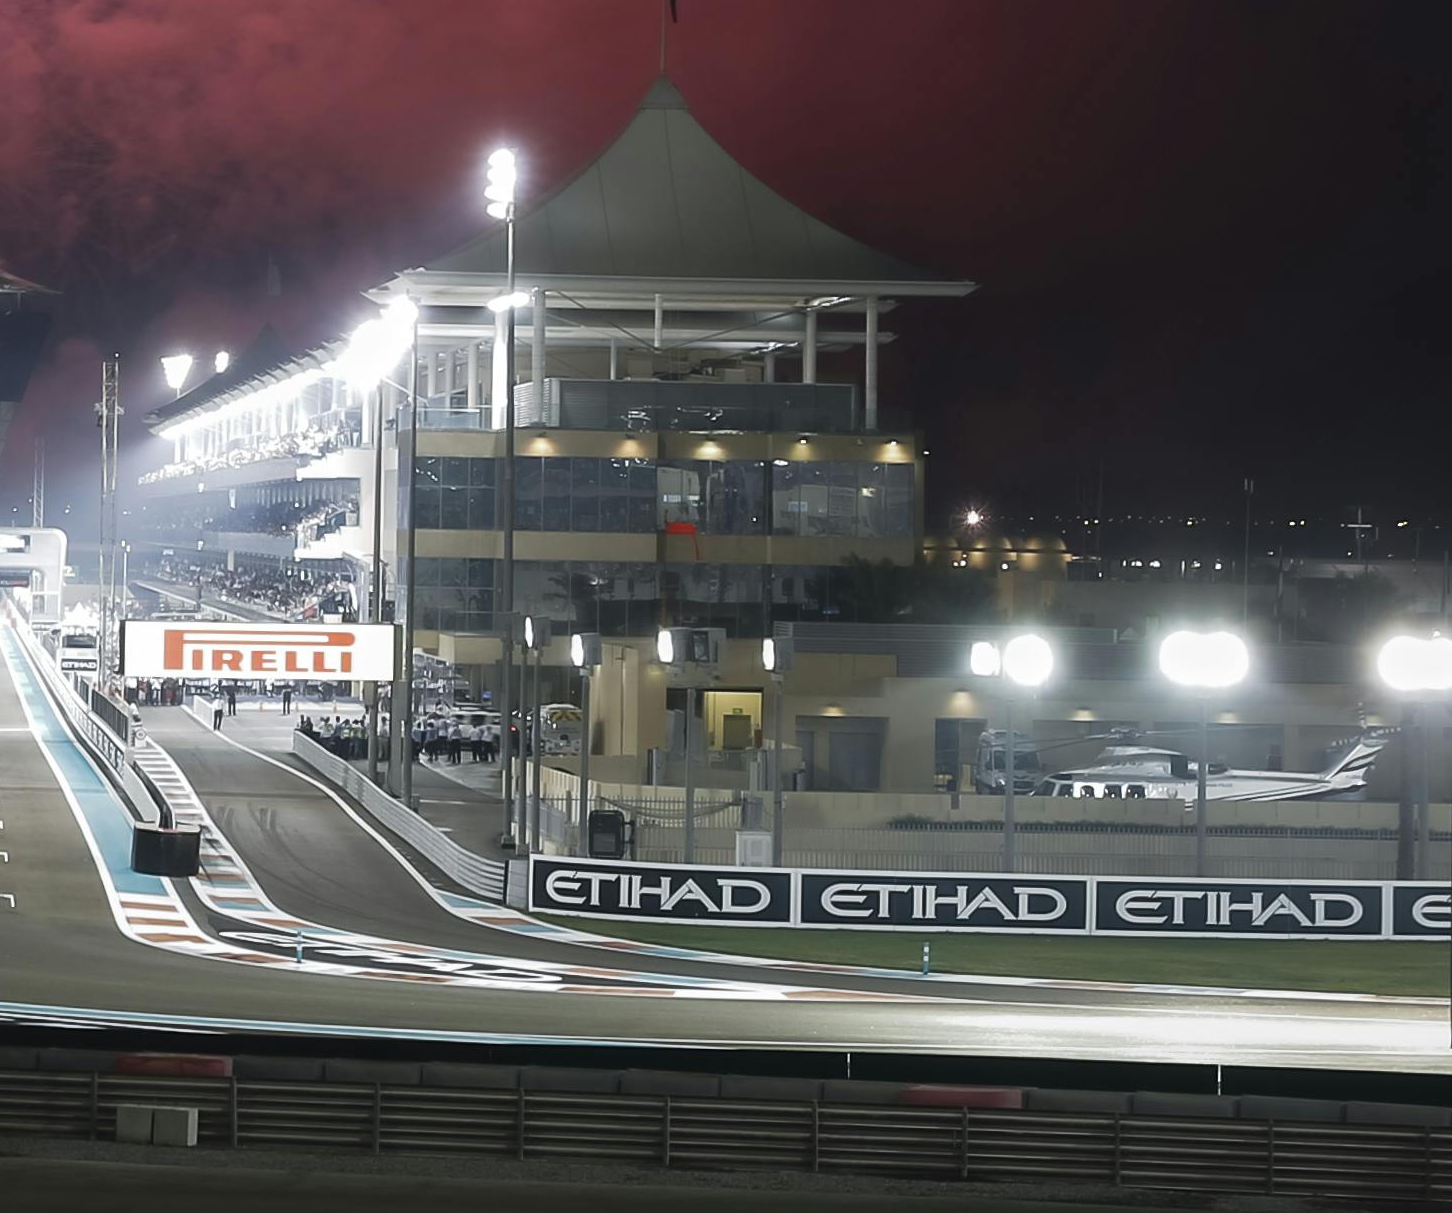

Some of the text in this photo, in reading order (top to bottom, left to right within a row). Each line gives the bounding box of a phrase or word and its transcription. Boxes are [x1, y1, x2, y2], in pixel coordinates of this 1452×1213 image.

[164, 630, 356, 673] PIRELLI
[545, 869, 772, 915] ETIHAD
[820, 883, 1068, 921] ETIHAD
[1114, 889, 1365, 927] ETIHAD
